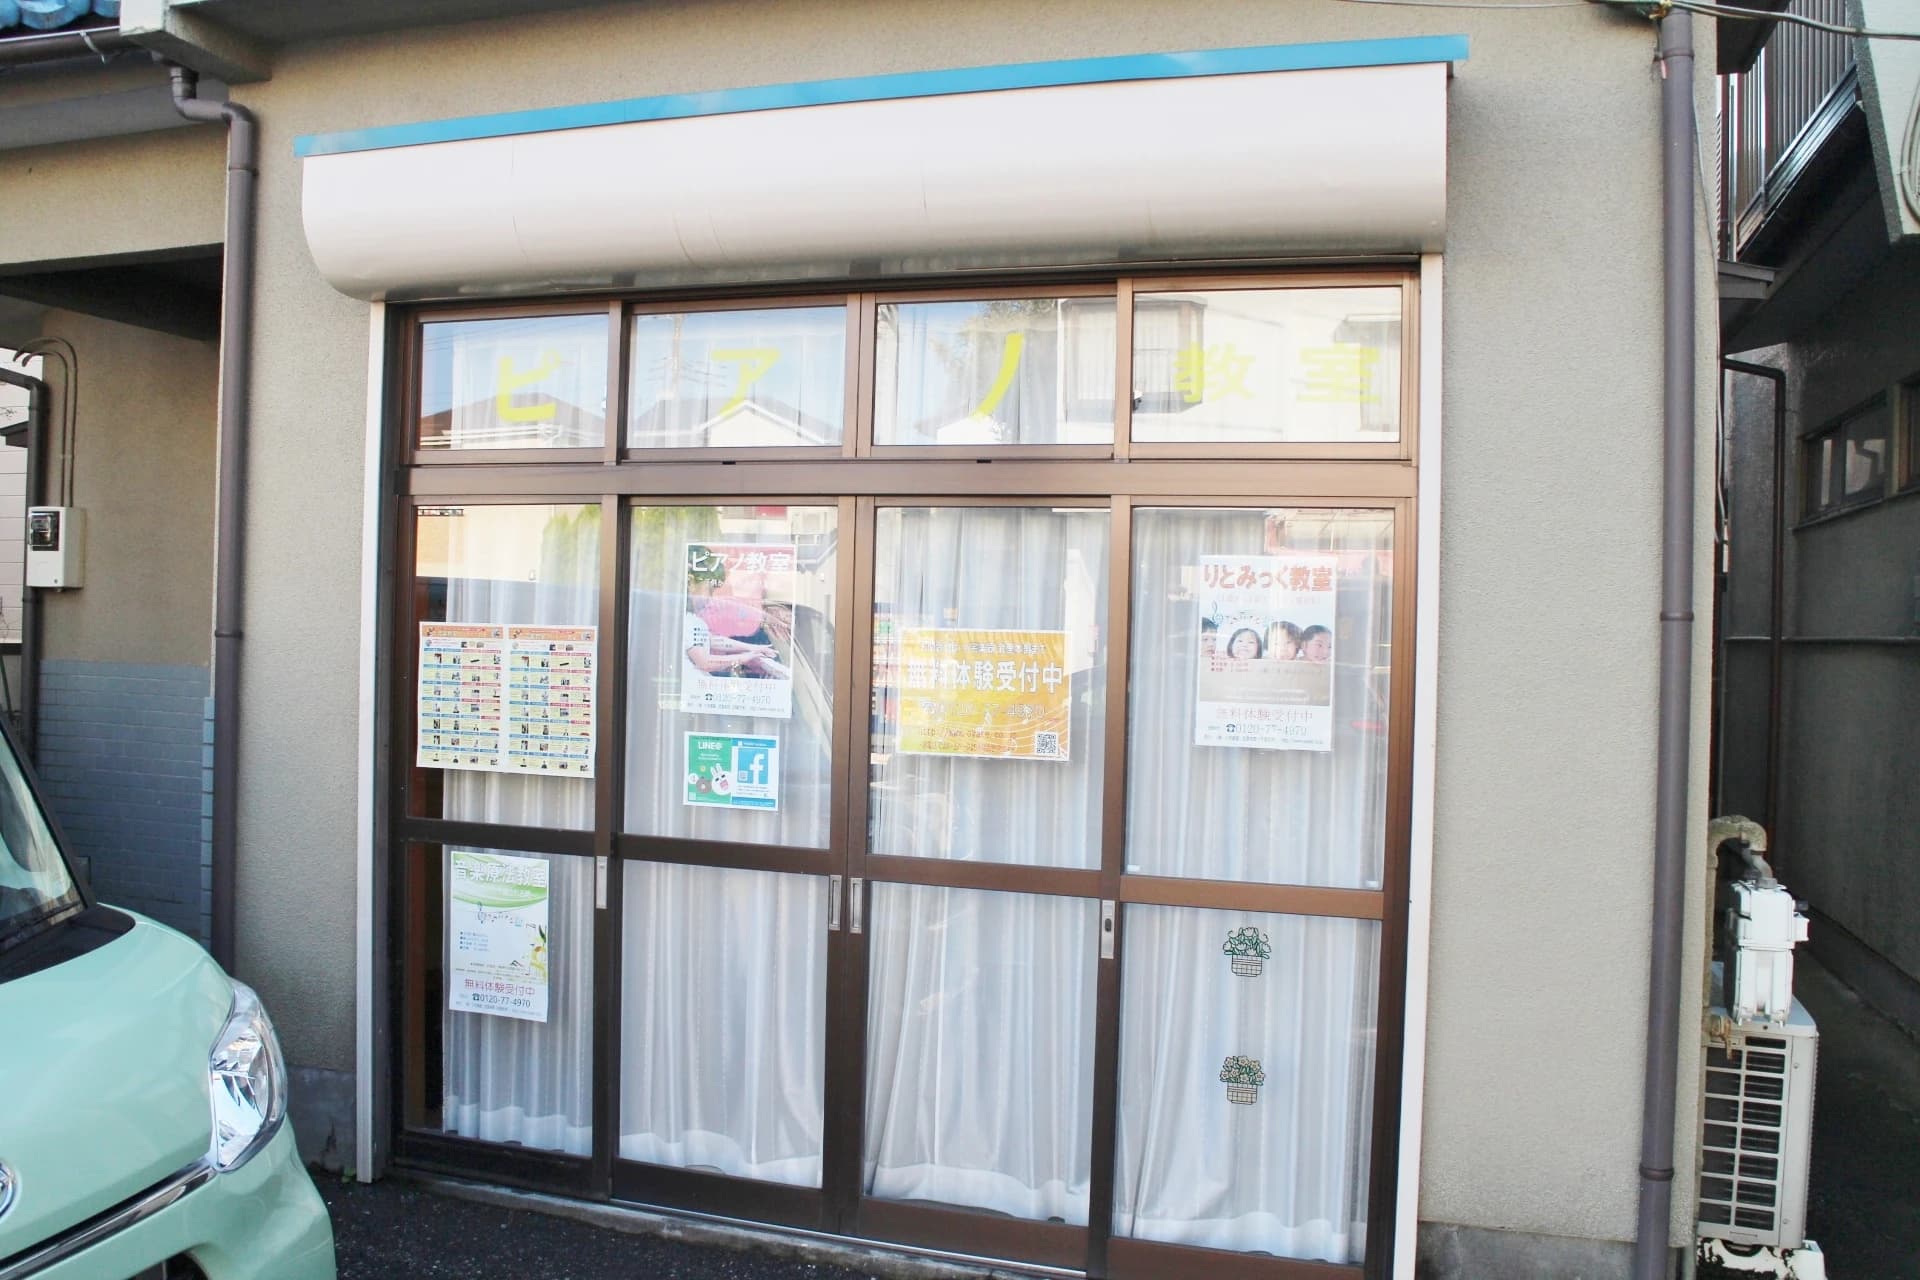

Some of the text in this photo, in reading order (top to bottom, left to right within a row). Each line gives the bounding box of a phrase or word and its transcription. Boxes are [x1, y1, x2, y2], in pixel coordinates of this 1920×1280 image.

[692, 551, 790, 573] ピアノ教室
[1204, 564, 1333, 592] りとみっく教室
[908, 659, 1064, 694] 無料体験受付中
[464, 978, 535, 996] 無料体験受付中
